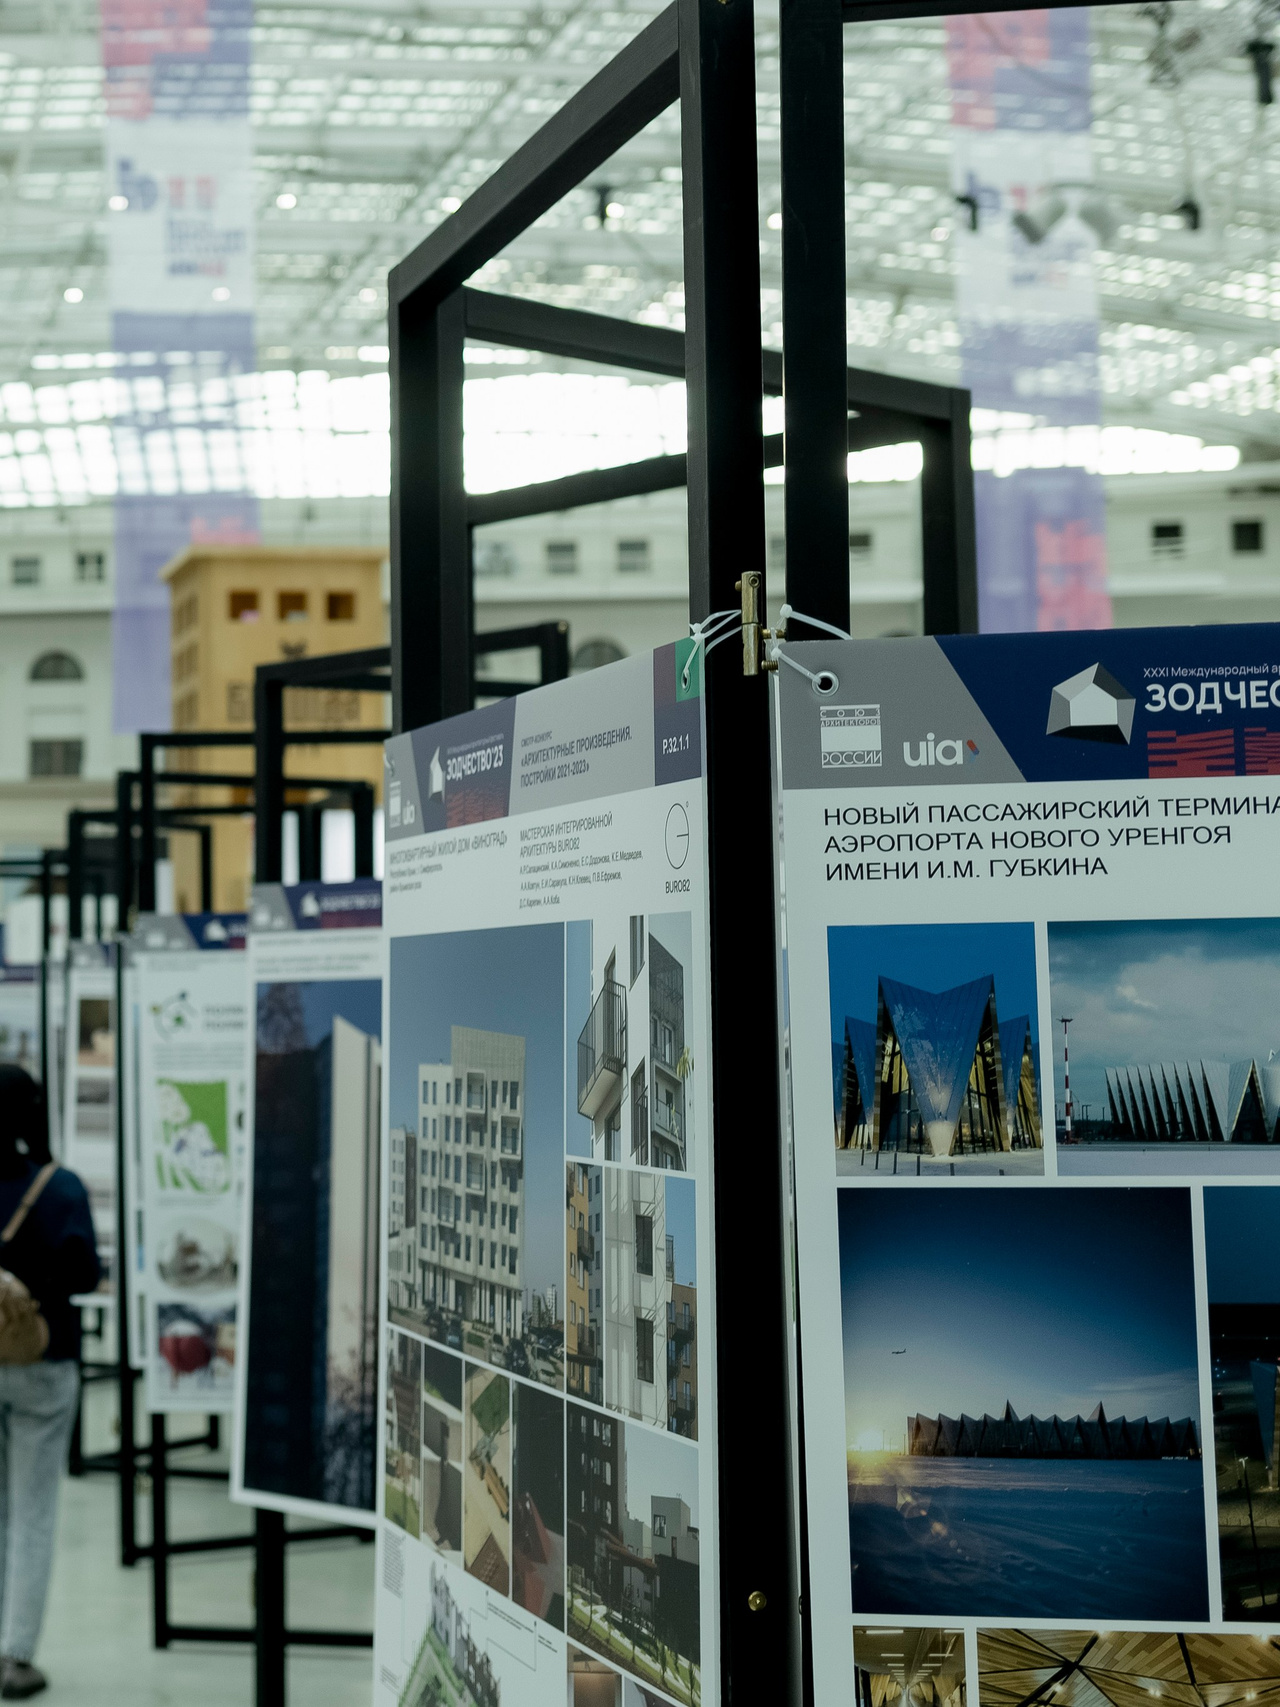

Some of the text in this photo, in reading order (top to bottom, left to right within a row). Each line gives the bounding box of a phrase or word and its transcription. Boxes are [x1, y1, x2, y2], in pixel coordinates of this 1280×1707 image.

[1144, 667, 1169, 678] XXXI
[1171, 663, 1269, 678] Международный
[820, 709, 881, 718] СОЮЗ
[821, 718, 881, 728] АРХИТЕКТОРОВ
[521, 741, 575, 768] «АРХИТЕКТУРНЫЕ
[576, 725, 633, 753] ПРОИЗВЕДЕНИЯ.
[822, 750, 883, 766] РОССИИ
[903, 732, 964, 767] uia
[520, 759, 590, 789] ПОСТРОЙКИ 2021-2023»
[824, 802, 919, 826] НОВЫЙ
[928, 795, 1150, 823] ПАССАЖИРСКИЙ
[520, 811, 613, 842] МАСТЕРСКАЯ ИНТЕГРИРОВАННОЙ
[520, 841, 557, 859] АРХИТЕКТУРЫ
[824, 825, 1231, 854] АЭРОПОРТА НОВОГО УРЕНГОЯ
[826, 857, 1108, 881] ИМЕНИ И.М. ГУБКИНА
[665, 879, 691, 894] BURO82
